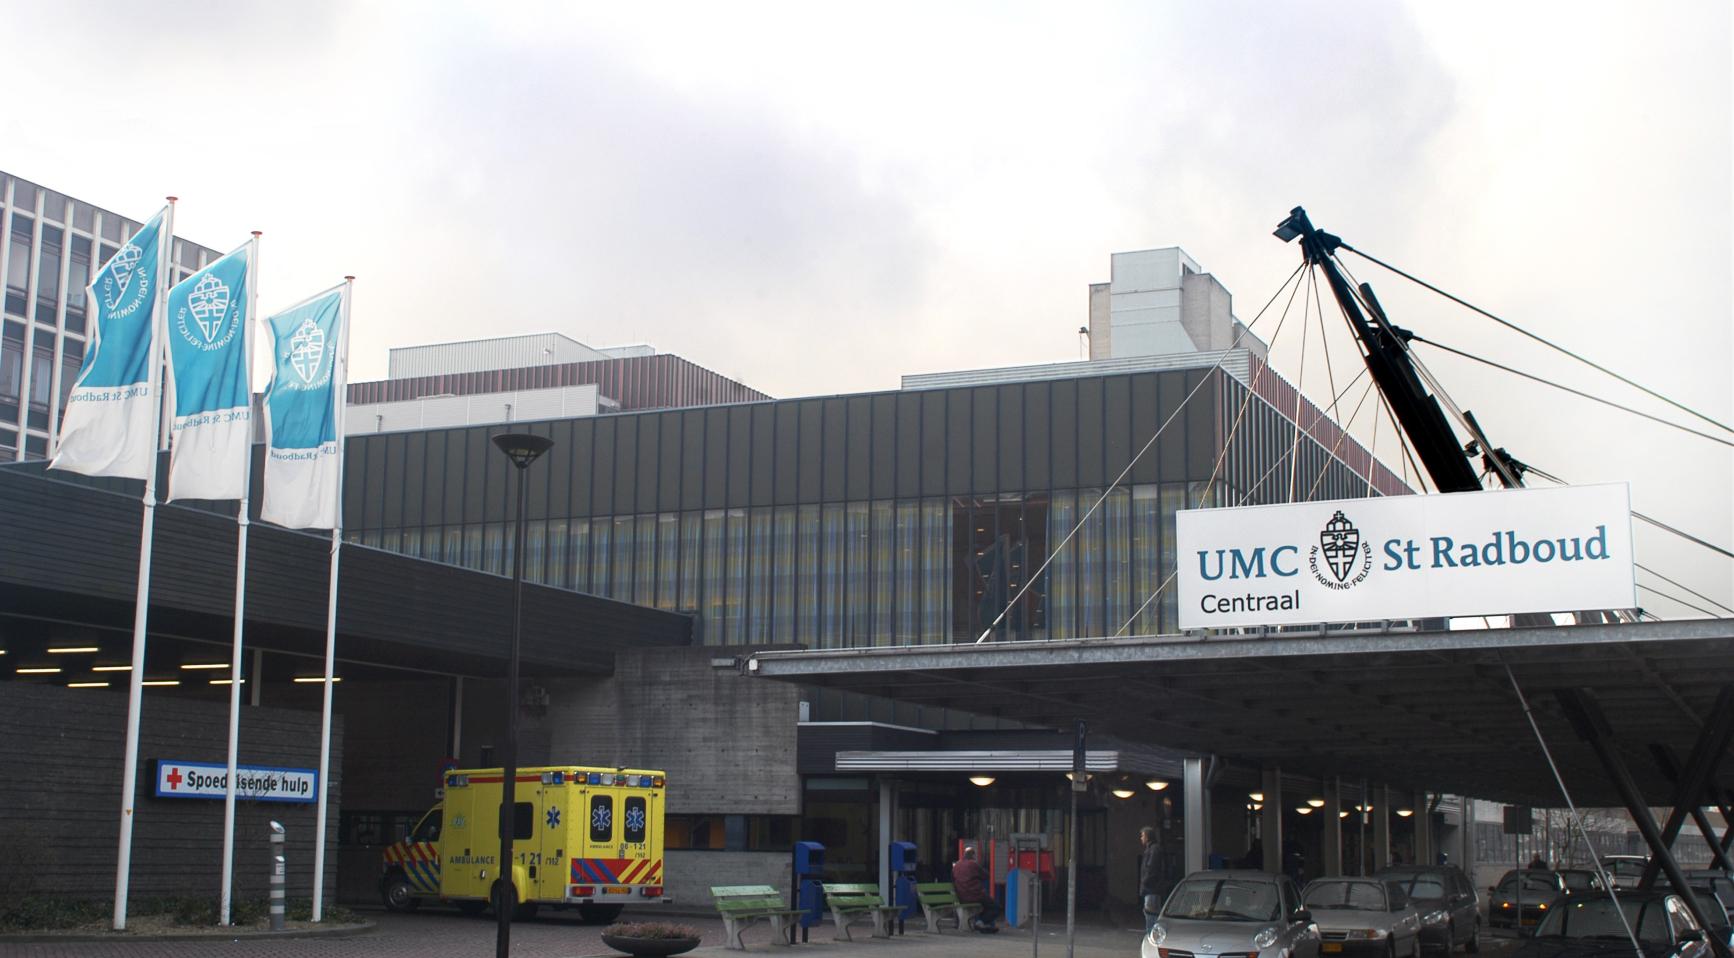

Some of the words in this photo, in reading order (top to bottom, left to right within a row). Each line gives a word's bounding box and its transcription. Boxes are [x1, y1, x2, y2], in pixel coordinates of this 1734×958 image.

[1197, 545, 1299, 581] UMC
[1383, 539, 1421, 571] St
[1430, 525, 1610, 568] Radboud
[1201, 589, 1299, 614] Centraal
[187, 771, 277, 791] Spoedisende
[281, 777, 309, 795] hulp
[450, 855, 495, 865] AMBULANCE
